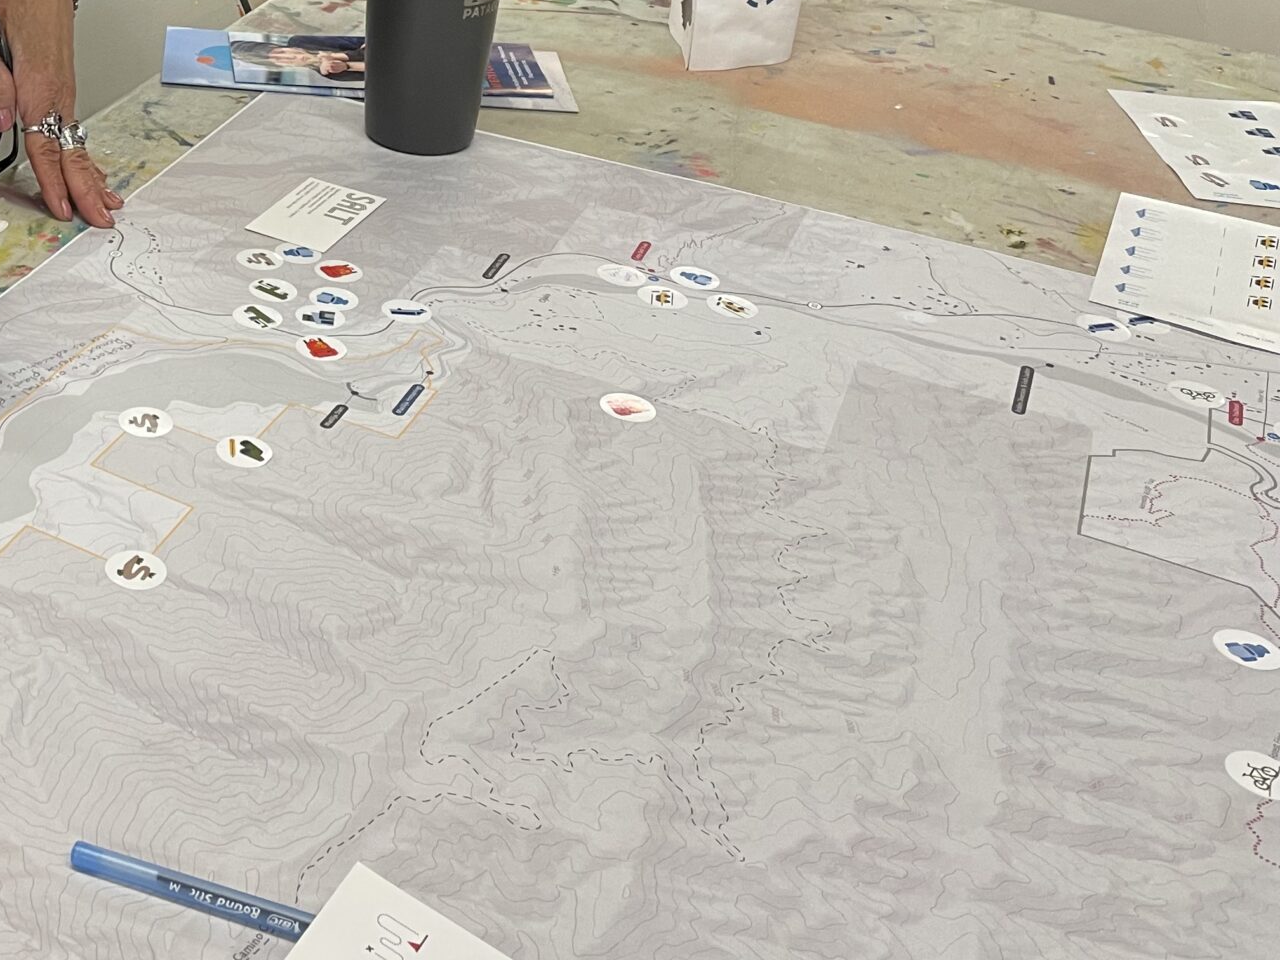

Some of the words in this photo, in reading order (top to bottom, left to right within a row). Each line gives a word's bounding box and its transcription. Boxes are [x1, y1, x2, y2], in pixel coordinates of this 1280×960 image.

[323, 192, 376, 226] SALT
[169, 881, 181, 893] M
[216, 897, 261, 919] Round
[232, 933, 264, 960] Camino
